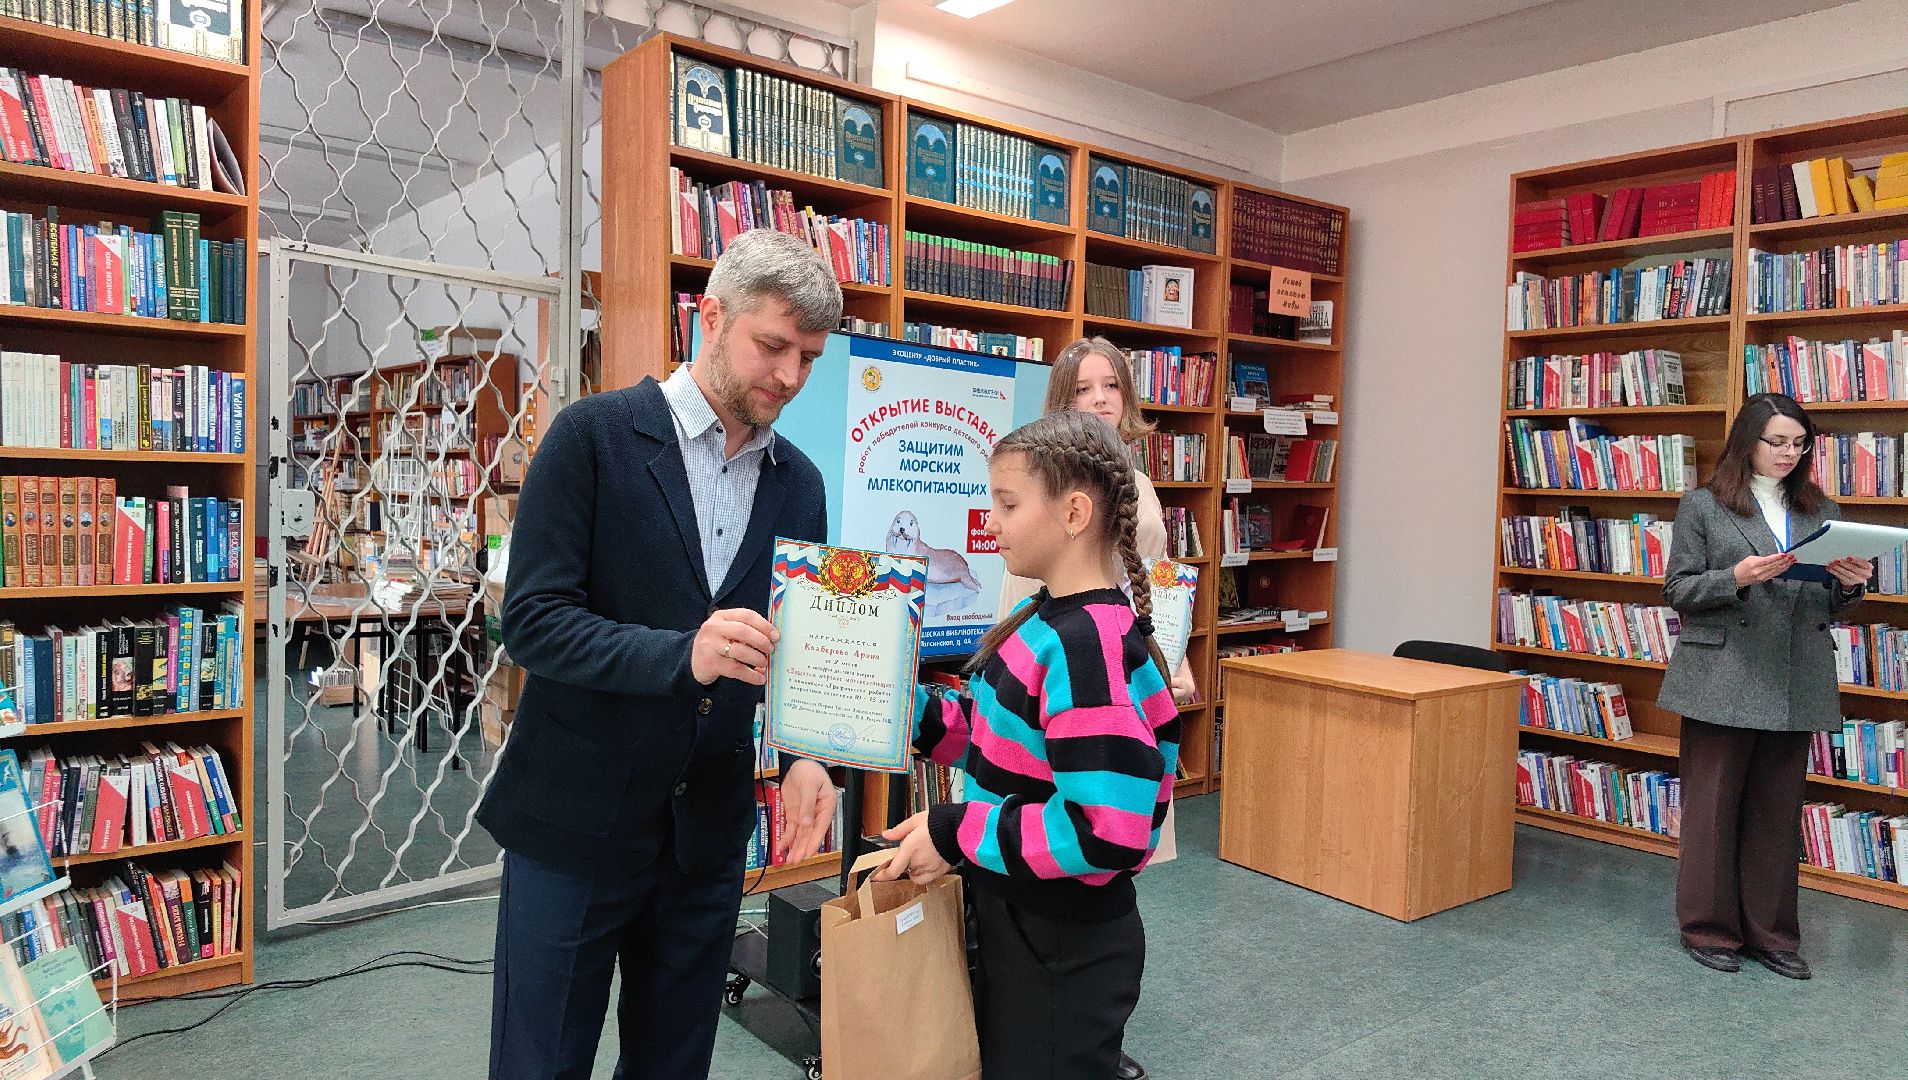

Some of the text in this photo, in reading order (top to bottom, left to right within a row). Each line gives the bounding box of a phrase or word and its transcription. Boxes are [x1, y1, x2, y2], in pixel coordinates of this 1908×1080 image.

[49, 223, 59, 266] ВСЕЛЕННАЯ
[892, 349, 923, 360] ЭКОЦЕНТР
[233, 391, 243, 449] СТРАНЫ МИРА
[851, 398, 930, 444] ОТКРЫТИЕ
[858, 446, 872, 474] работ
[872, 421, 919, 446] победителей
[920, 421, 952, 432] конкурса
[953, 429, 981, 449] детского
[898, 440, 964, 457] ЗАЩИТИМ
[899, 459, 961, 475] МОРСКИХ
[867, 478, 987, 498] МЛЕКОПИТАЮЩИХ
[971, 539, 997, 551] 14:00
[962, 612, 993, 620] свободный
